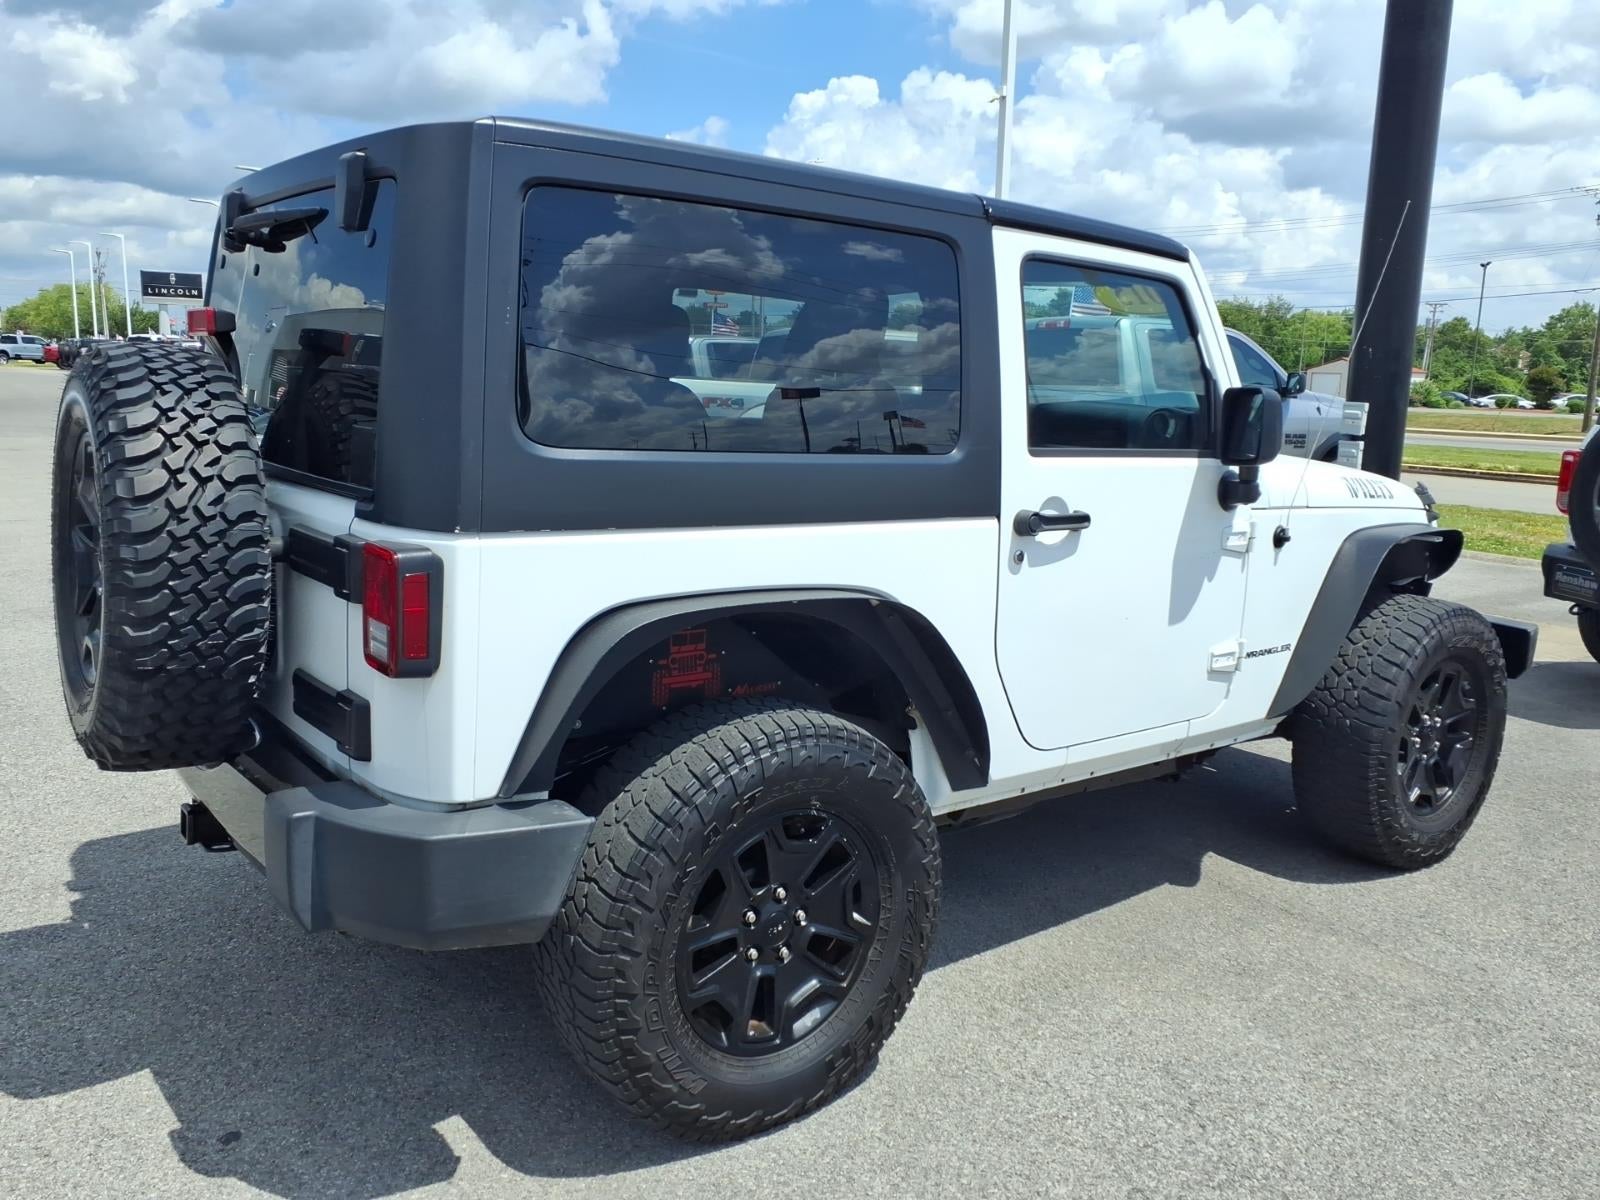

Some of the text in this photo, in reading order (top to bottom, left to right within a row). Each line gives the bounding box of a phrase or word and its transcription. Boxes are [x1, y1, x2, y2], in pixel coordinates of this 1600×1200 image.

[148, 287, 198, 296] LINCOLN
[1555, 571, 1599, 590] Renshaw
[1246, 643, 1292, 659] WRANGLER
